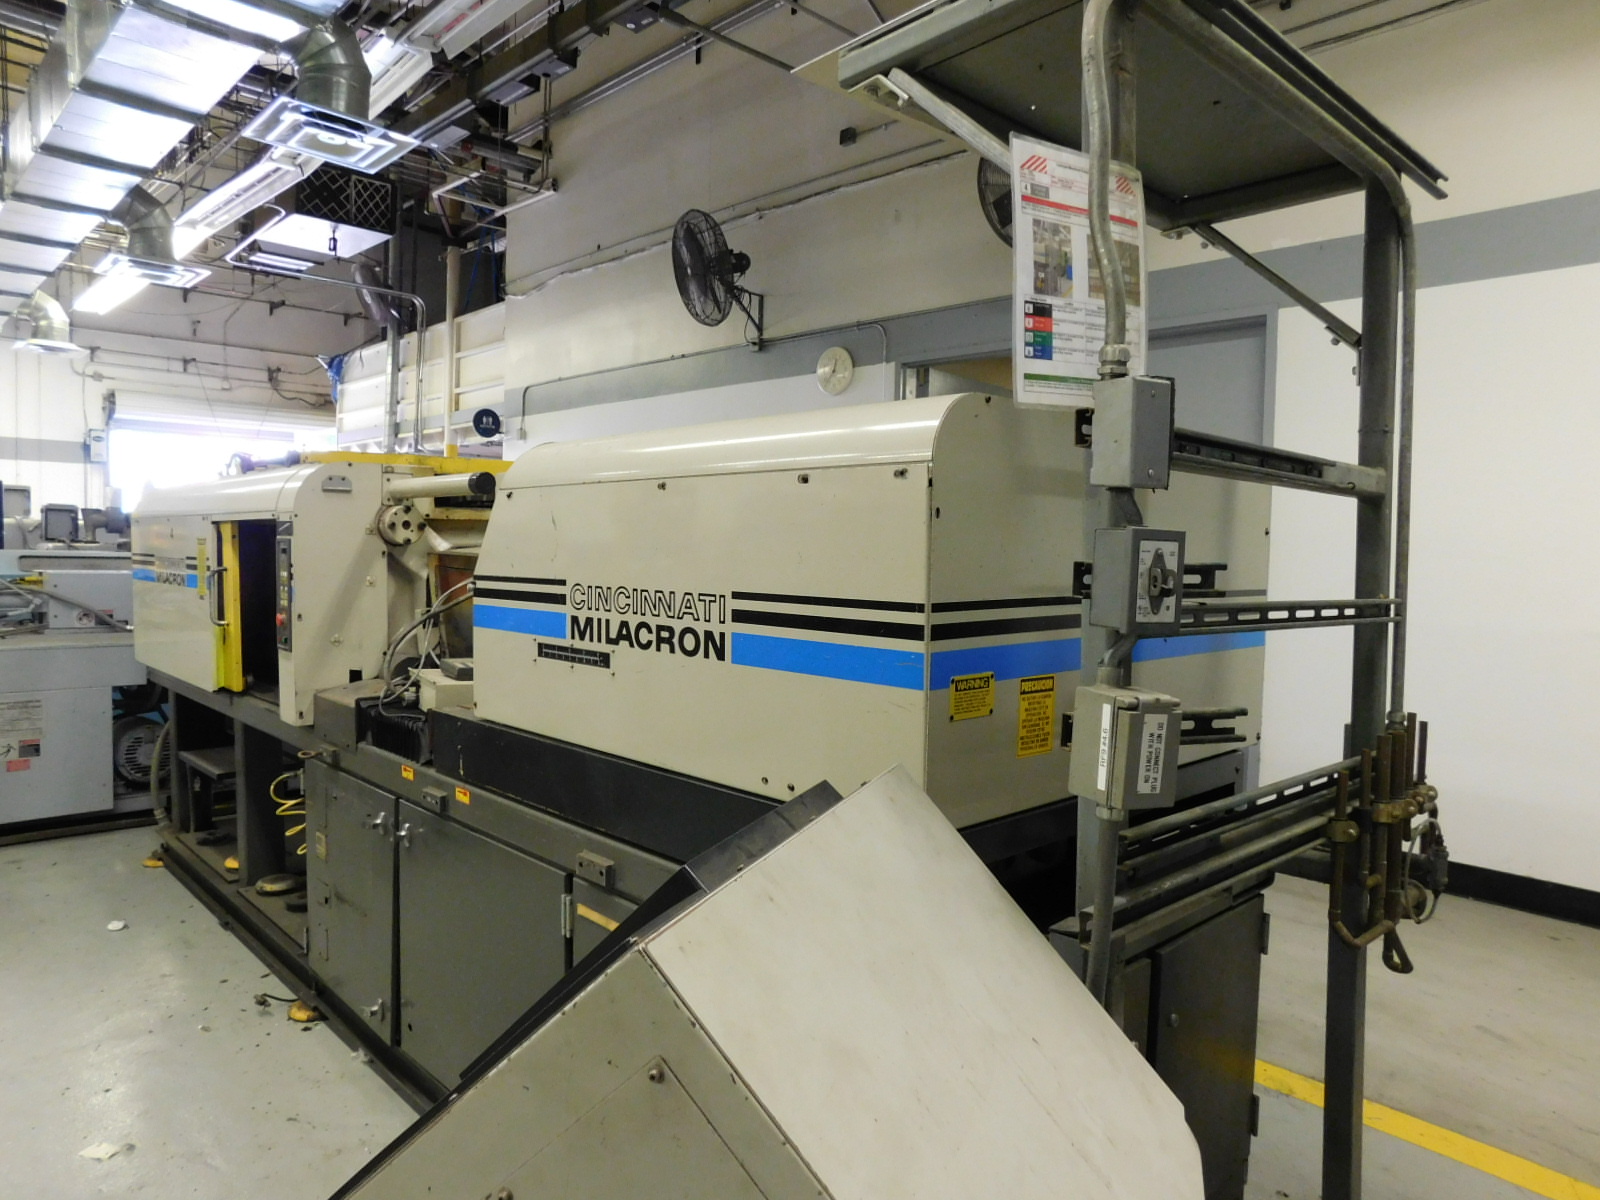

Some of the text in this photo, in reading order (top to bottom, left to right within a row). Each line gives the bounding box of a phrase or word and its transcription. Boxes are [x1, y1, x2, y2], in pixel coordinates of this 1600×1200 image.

[569, 583, 726, 624] CINCINNATI
[570, 615, 726, 661] MILACRON
[1145, 750, 1153, 773] POWER
[1153, 747, 1161, 774] CONNECT
[1144, 774, 1151, 784] ON
